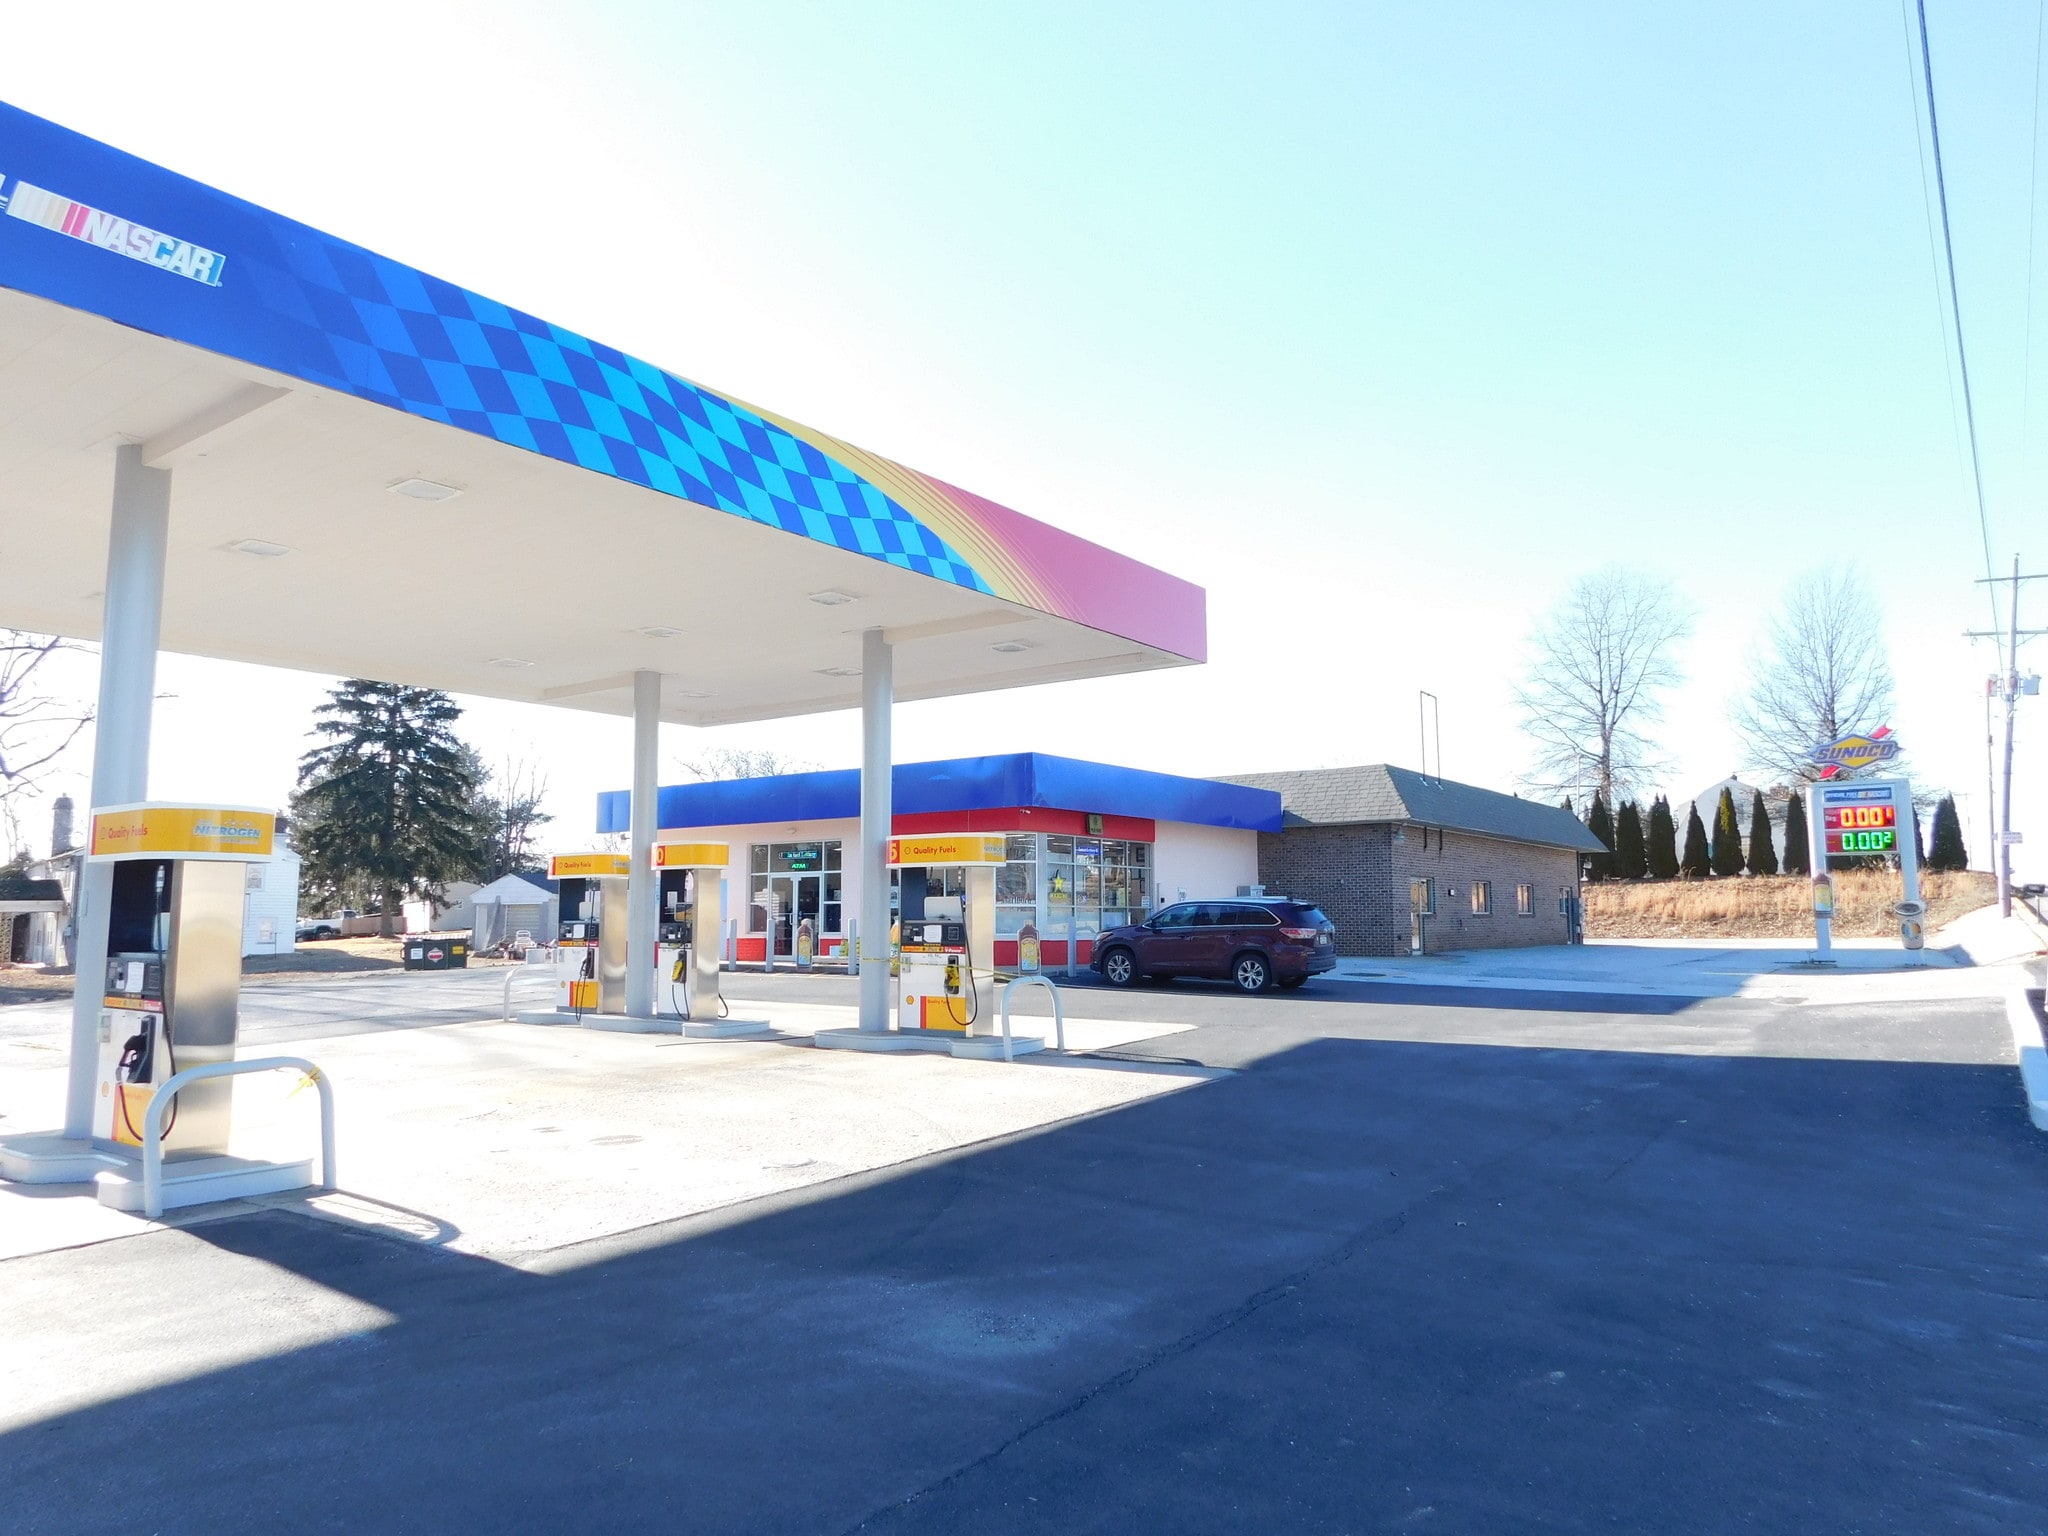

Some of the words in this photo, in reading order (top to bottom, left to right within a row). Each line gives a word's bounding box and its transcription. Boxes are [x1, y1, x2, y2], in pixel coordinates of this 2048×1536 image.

[79, 208, 216, 283] NASCAR
[1816, 744, 1894, 759] SUNOCO
[194, 824, 261, 838] NITROGEN
[913, 847, 937, 855] Quality
